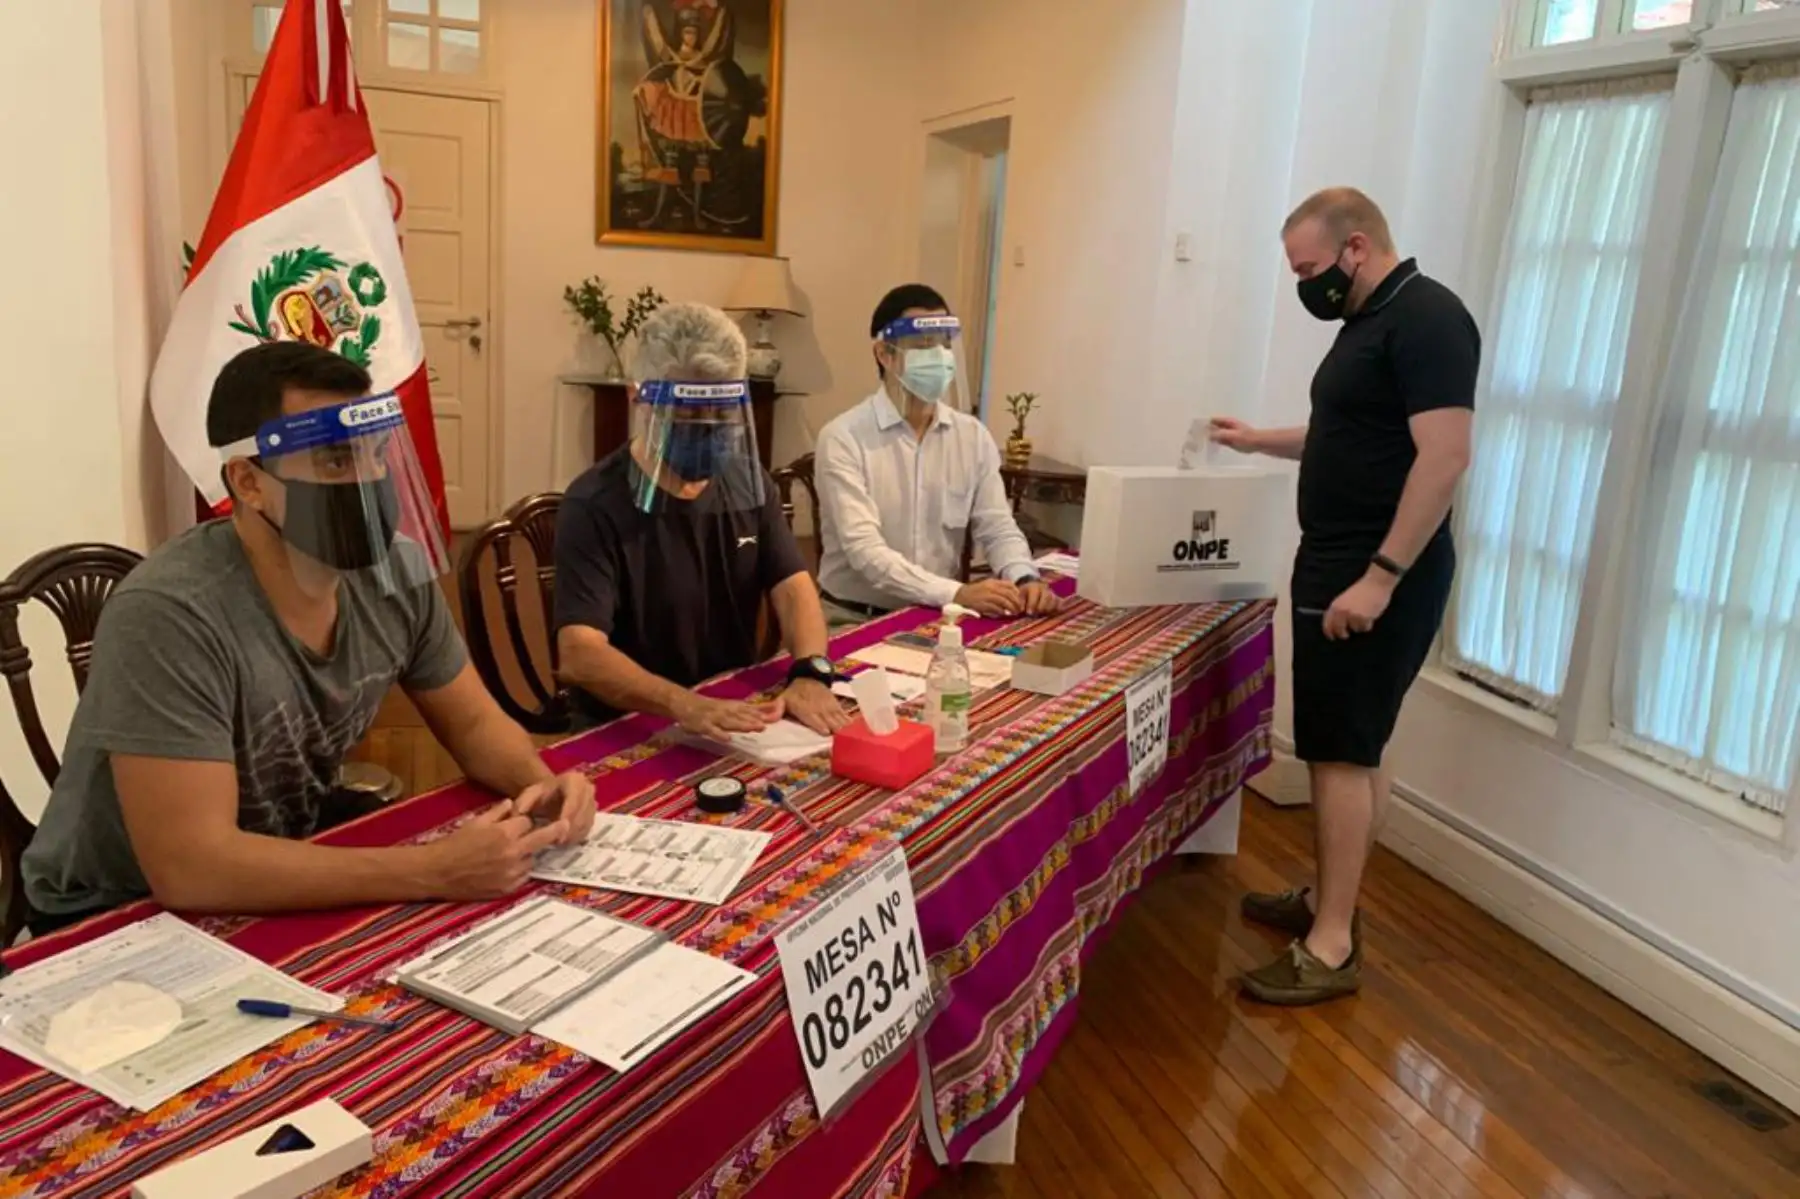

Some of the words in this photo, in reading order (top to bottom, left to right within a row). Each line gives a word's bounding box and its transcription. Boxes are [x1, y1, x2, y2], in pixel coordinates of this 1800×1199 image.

[679, 387, 707, 396] Face
[349, 407, 384, 422] Face
[1173, 538, 1230, 561] ONPE
[803, 916, 876, 994] MESA
[802, 927, 921, 1070] 082341
[861, 1017, 909, 1070] ONPE
